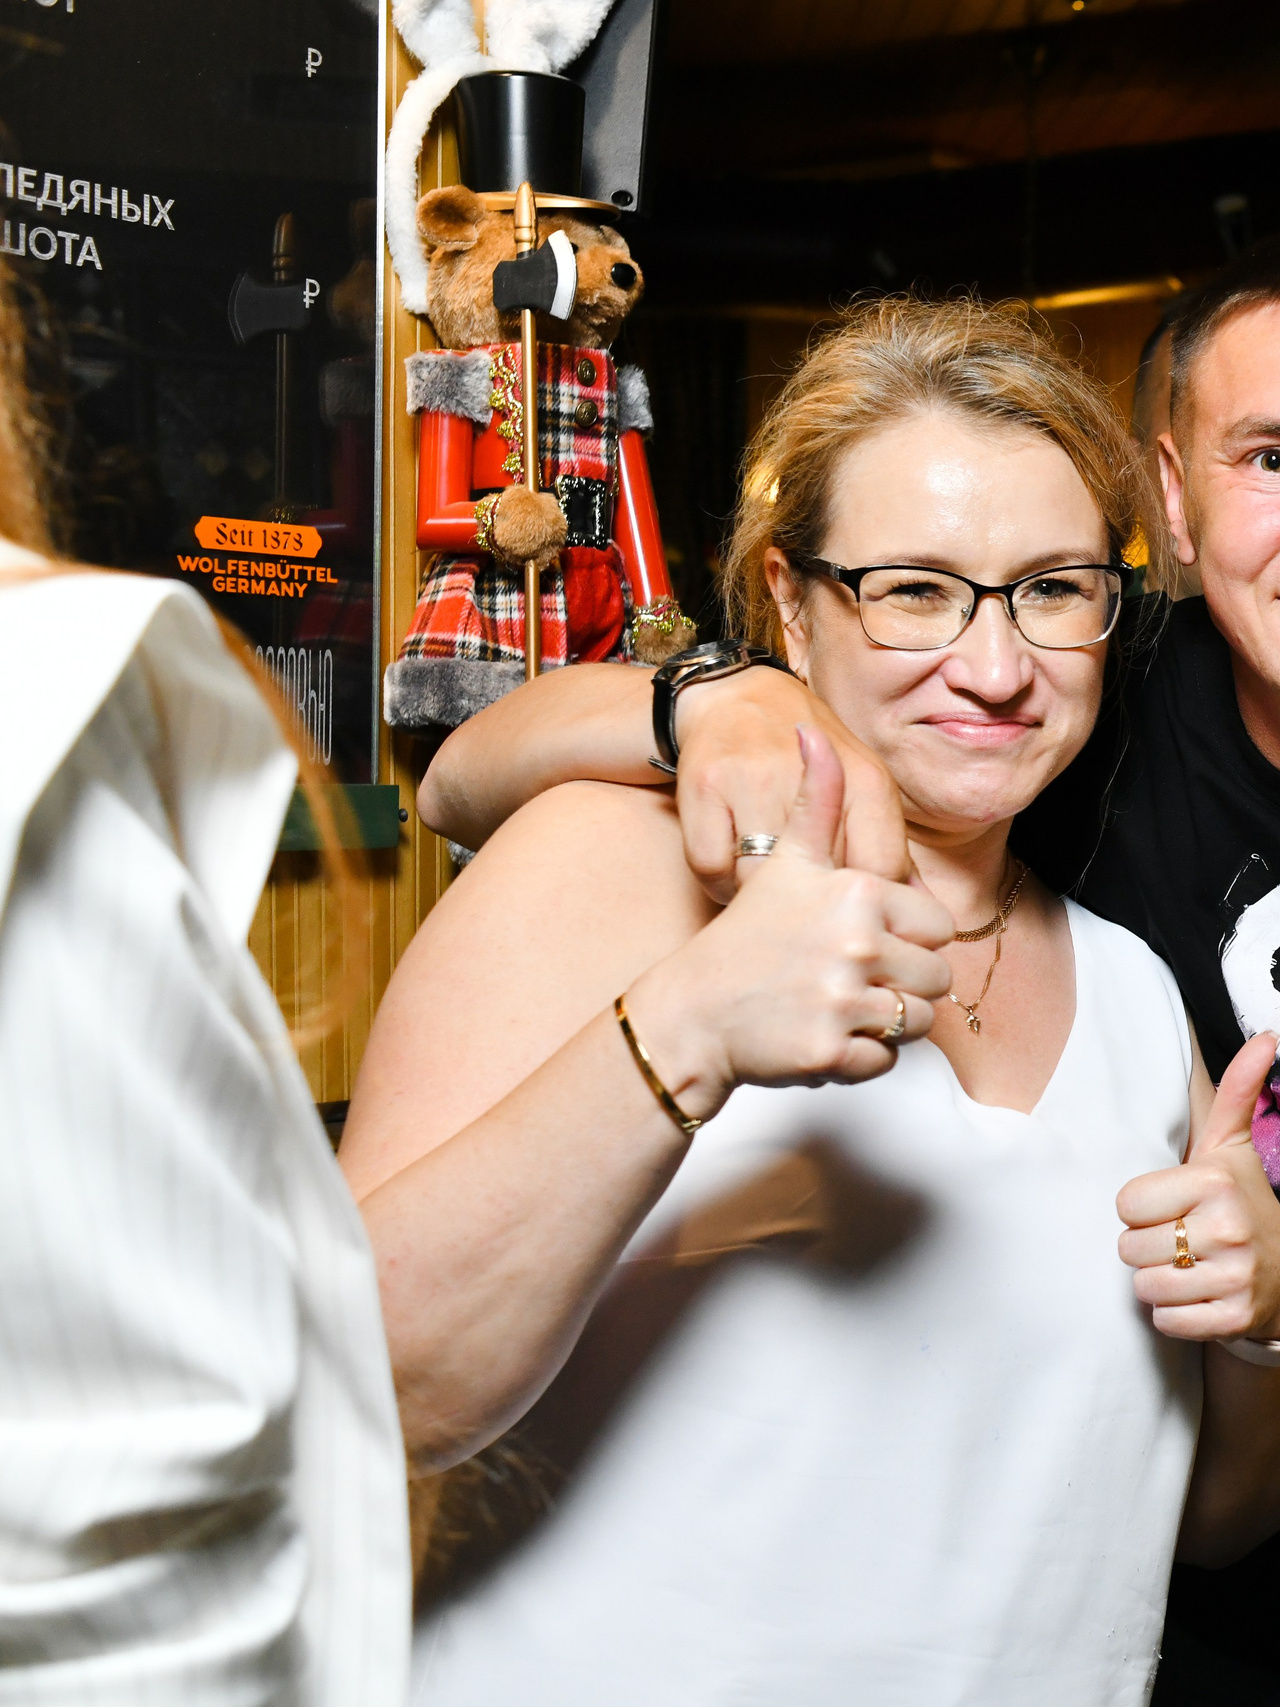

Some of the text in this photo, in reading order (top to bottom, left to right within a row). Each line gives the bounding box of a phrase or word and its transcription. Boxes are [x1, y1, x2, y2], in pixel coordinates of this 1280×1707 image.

[215, 522, 254, 547] Seit
[176, 554, 339, 584] WOLFENBÜTTEL
[212, 576, 308, 598] GERMANY
